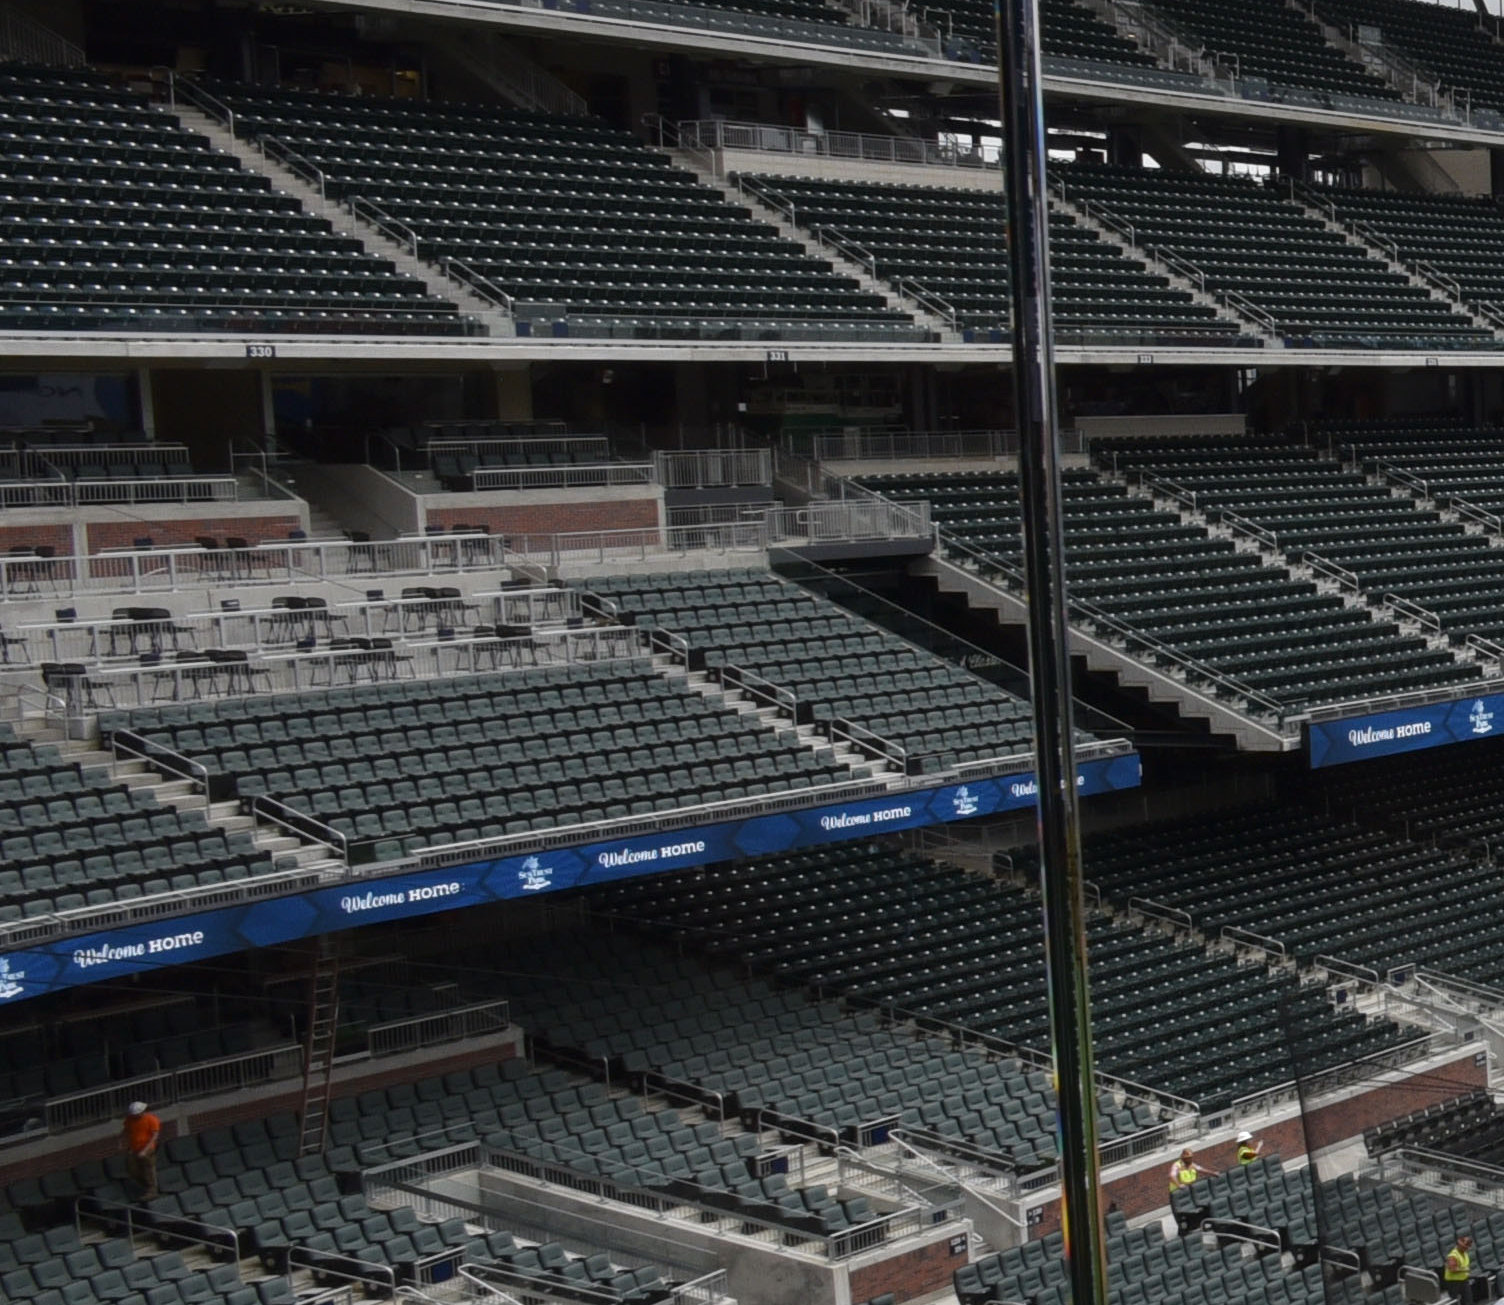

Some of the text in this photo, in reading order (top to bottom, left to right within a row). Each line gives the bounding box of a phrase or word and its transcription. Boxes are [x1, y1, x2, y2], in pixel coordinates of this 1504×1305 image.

[1349, 726, 1394, 746] Welcome
[821, 813, 870, 830] Welcome
[599, 849, 657, 868] Welcome
[341, 892, 404, 913] Welcome
[73, 943, 145, 969] Welcome
